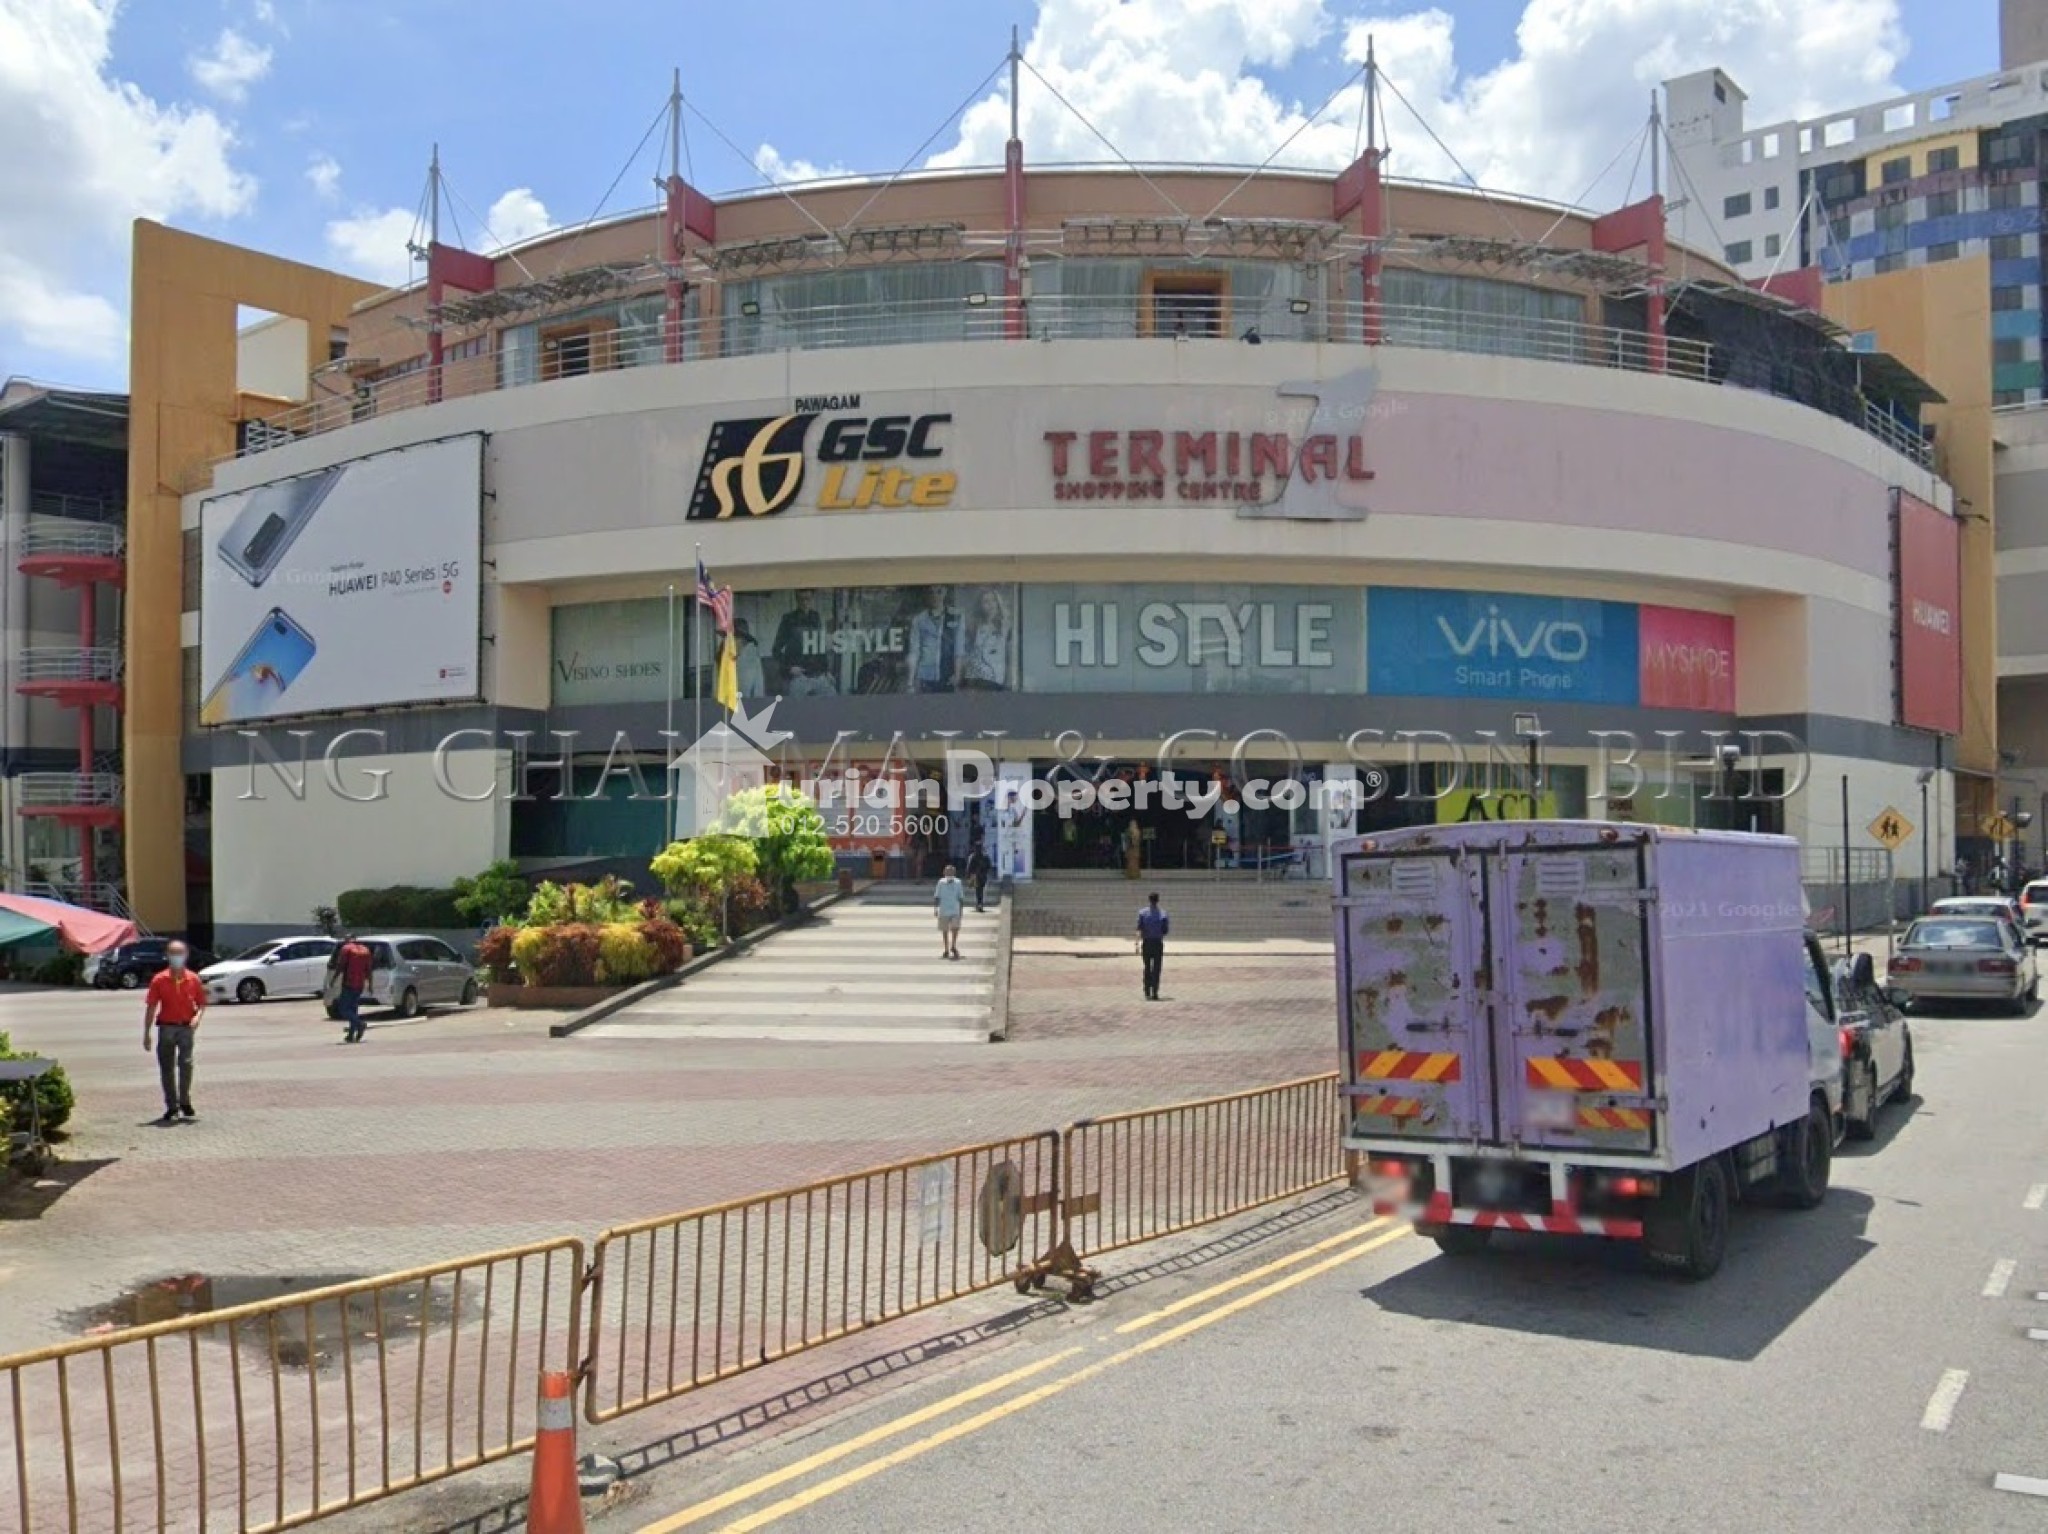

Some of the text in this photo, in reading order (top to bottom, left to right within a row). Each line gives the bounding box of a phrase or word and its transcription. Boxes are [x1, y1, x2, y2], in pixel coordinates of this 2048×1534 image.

[795, 394, 860, 413] PAWAGAM
[817, 413, 953, 462] GSC
[1043, 430, 1375, 483] TERMINAL
[816, 463, 958, 511] Lite
[1054, 480, 1262, 502] SHOPPING CENTRE
[329, 574, 378, 597] HUAWEI
[382, 570, 401, 588] P40
[404, 566, 436, 585] Series
[442, 561, 459, 579] 5G
[802, 626, 904, 655] HI STYLE
[1054, 602, 1334, 667] HI STYLE
[1436, 603, 1588, 662] vivo
[615, 661, 661, 680] SHOES
[1455, 665, 1572, 689] Smart Phone
